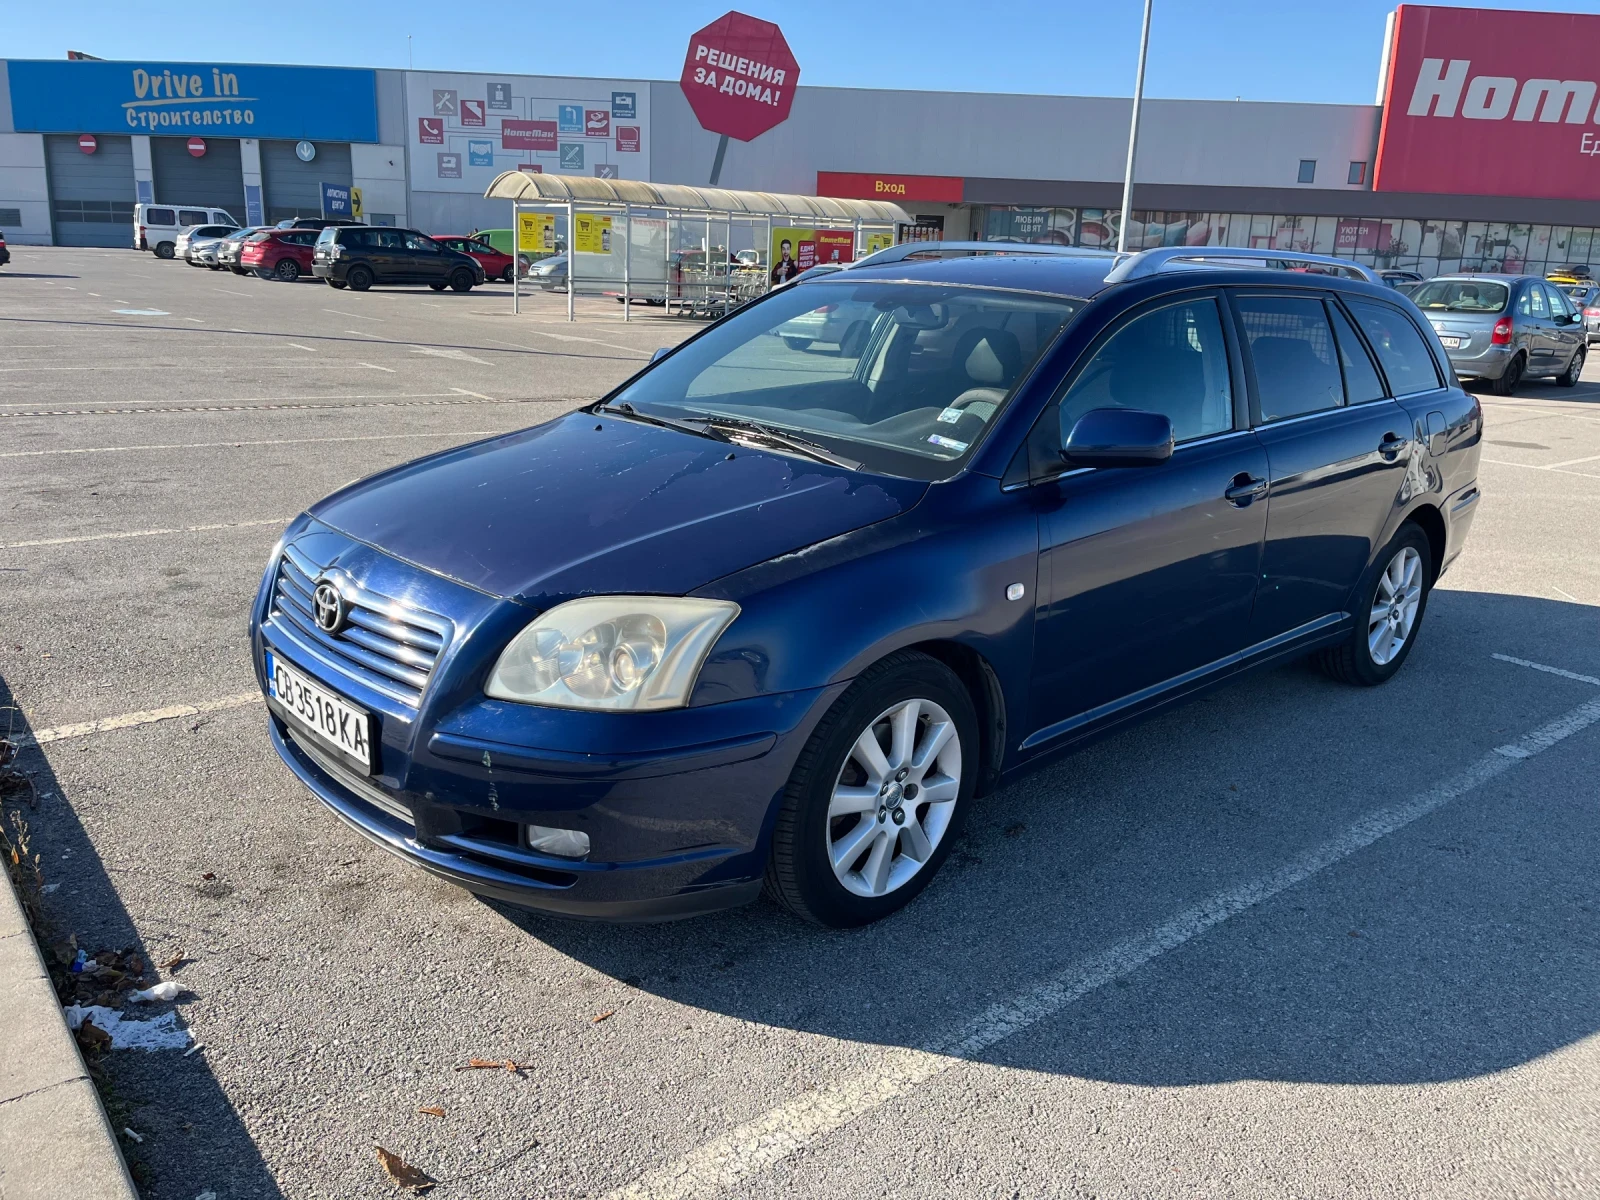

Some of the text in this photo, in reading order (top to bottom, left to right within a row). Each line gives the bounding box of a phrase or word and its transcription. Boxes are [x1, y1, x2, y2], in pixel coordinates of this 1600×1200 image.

[695, 44, 786, 86] РЕШЕНИЯ
[132, 67, 239, 99] Drive in
[693, 67, 781, 107] ЗА ДОМА!
[1407, 57, 1600, 125] Hom
[126, 107, 255, 131] Строителство
[503, 127, 555, 138] HomeMax
[875, 180, 906, 195] Вход
[1014, 215, 1044, 224] ЛЮБИМ
[1020, 224, 1042, 234] ЦВЯТ
[1340, 226, 1369, 235] УЮТЕН
[1338, 235, 1357, 244] ДОМ
[799, 244, 815, 253] ЕДНО
